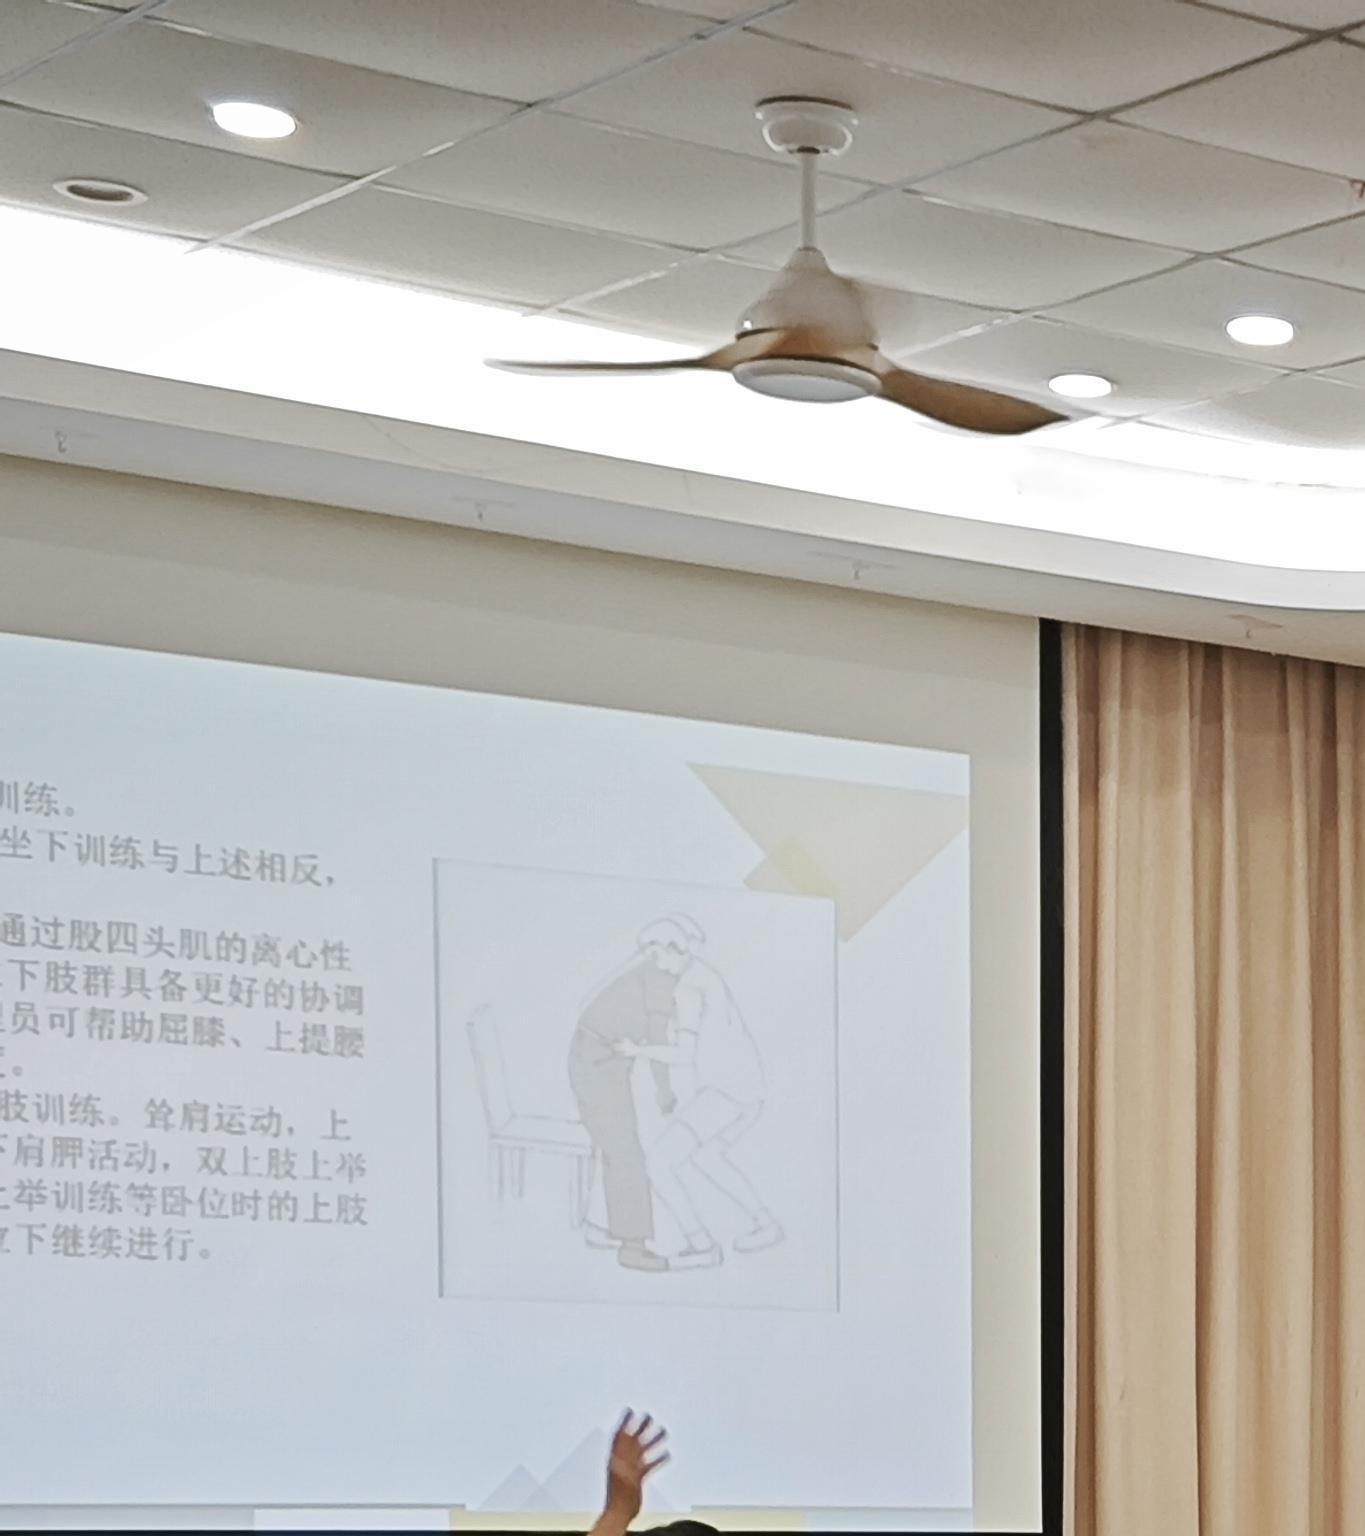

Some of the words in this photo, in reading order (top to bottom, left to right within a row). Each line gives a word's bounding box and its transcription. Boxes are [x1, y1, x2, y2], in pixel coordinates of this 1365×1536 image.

[0, 959, 364, 1016] 下肢群具备更好的协调
[0, 1002, 364, 1059] 员可帮助屈膝、上提腰
[0, 1134, 366, 1184] 肩胛活动，双上肢上举
